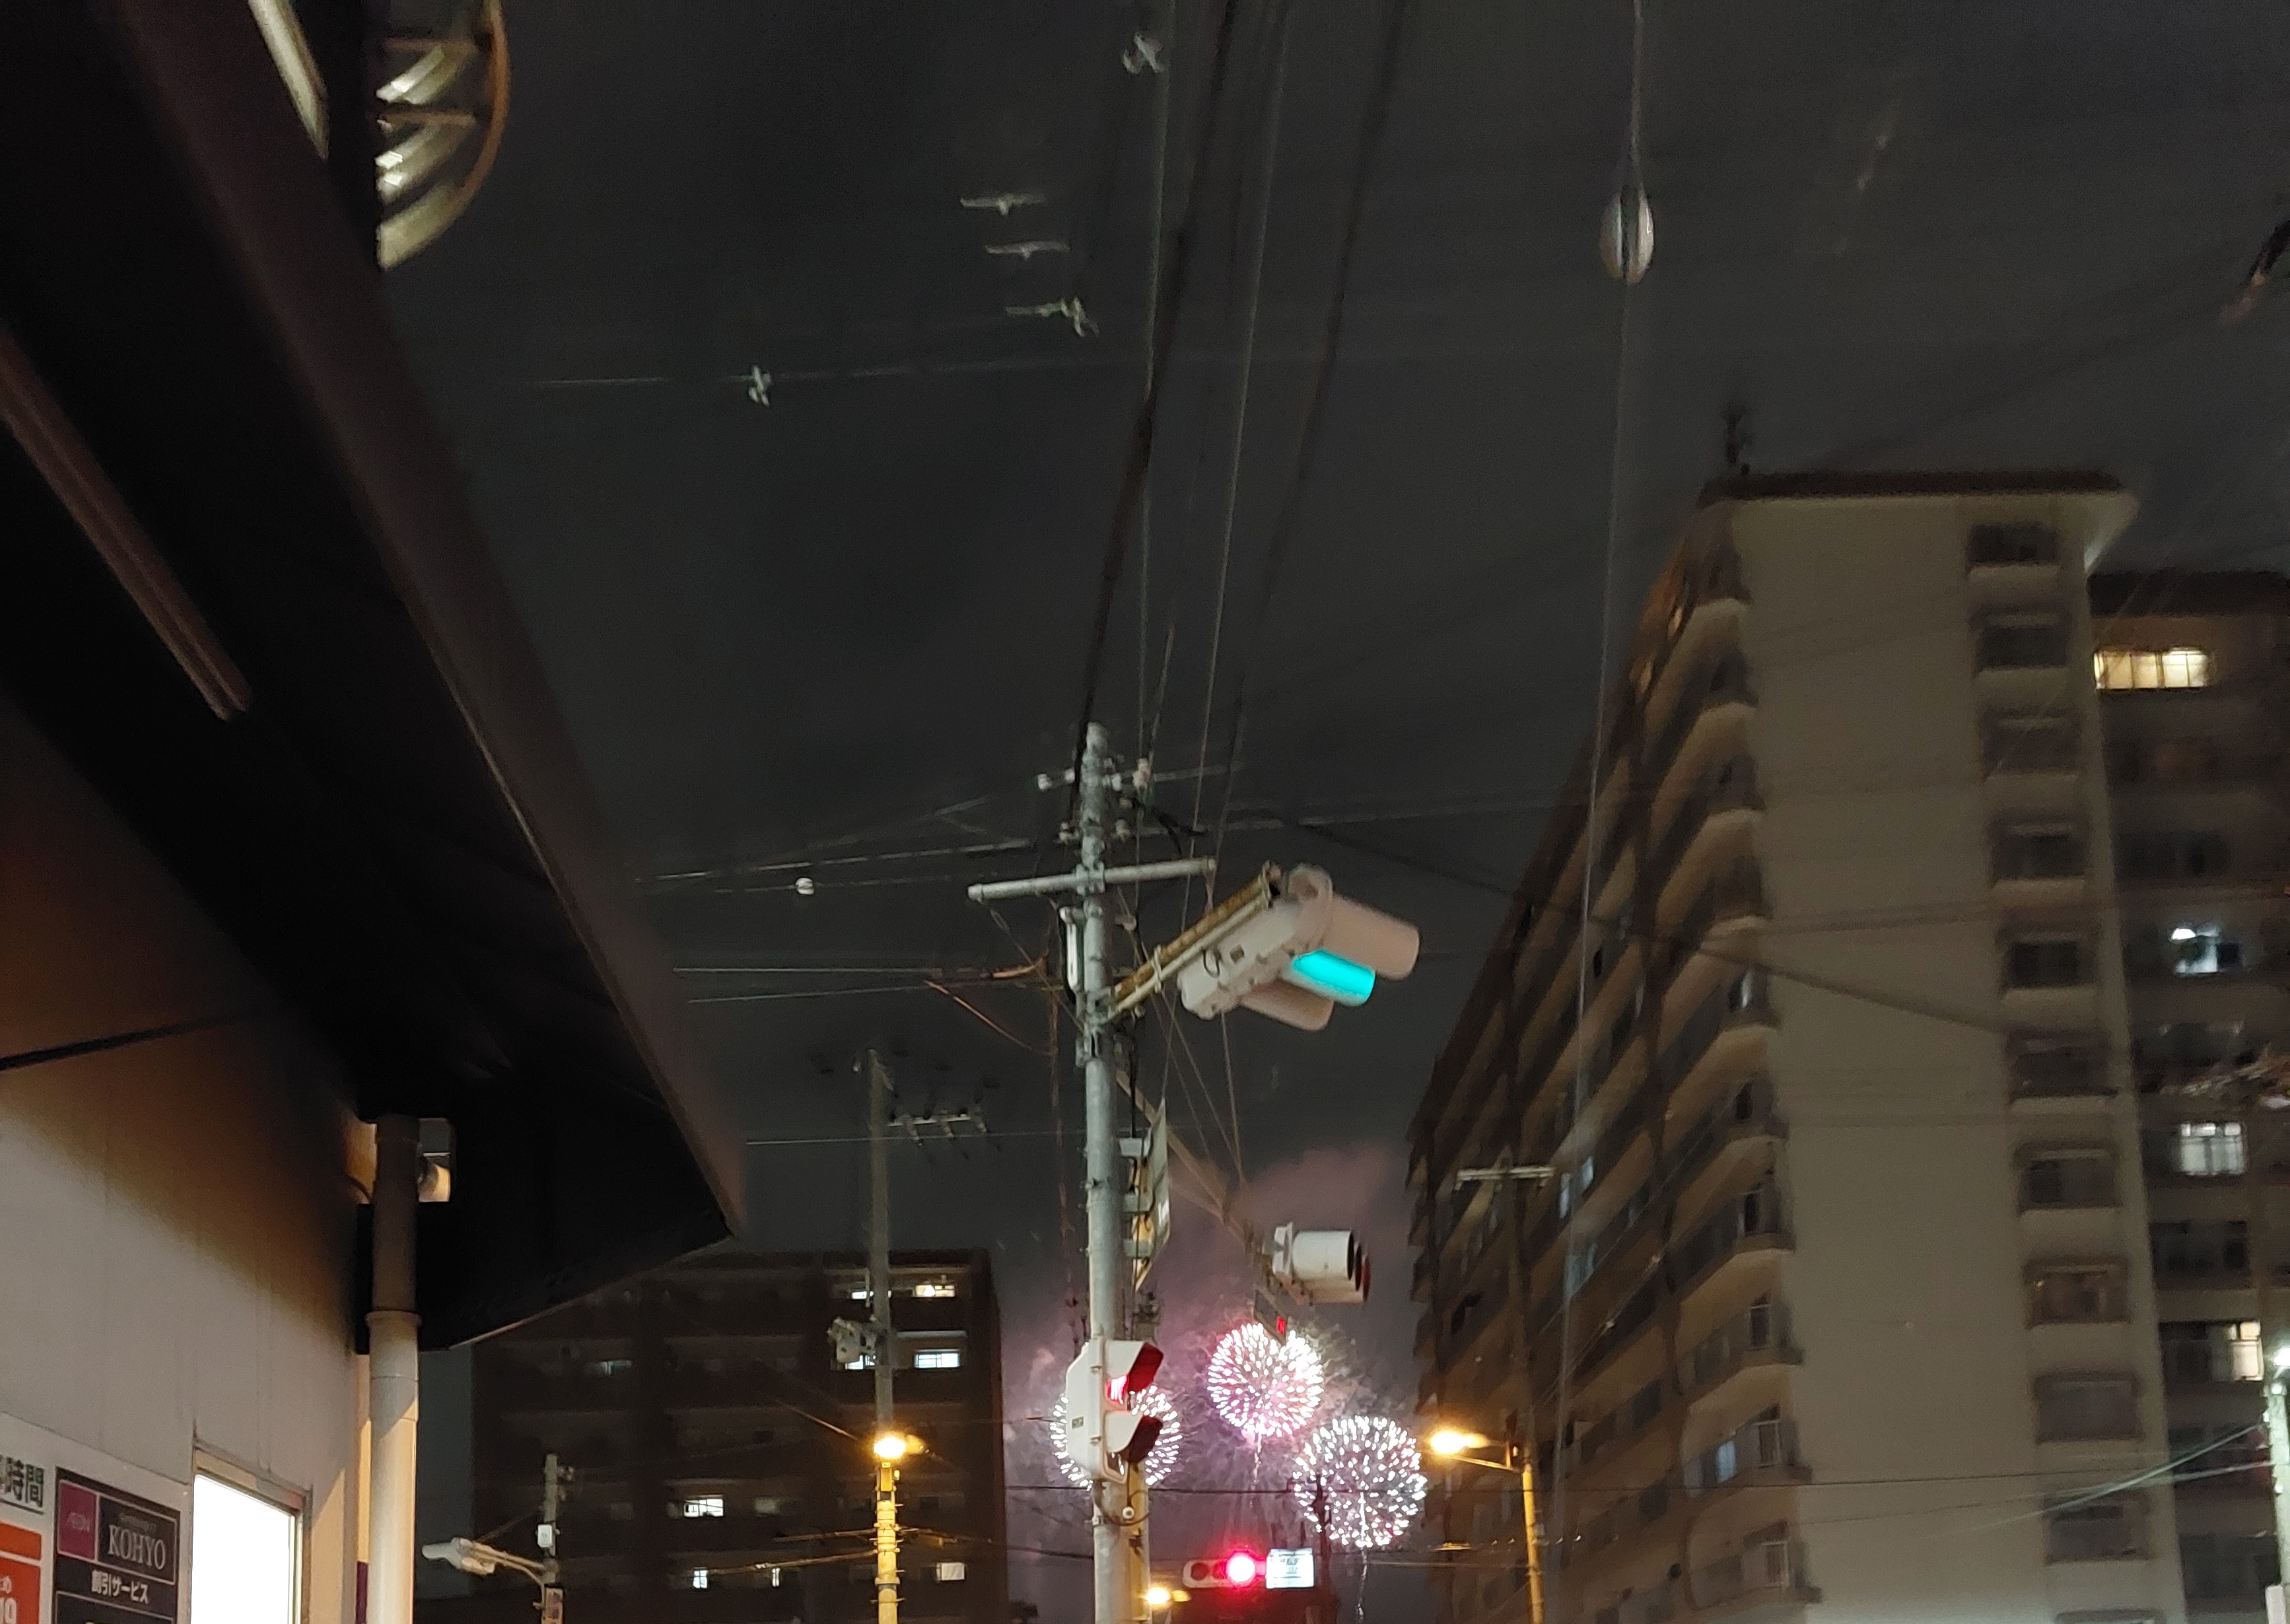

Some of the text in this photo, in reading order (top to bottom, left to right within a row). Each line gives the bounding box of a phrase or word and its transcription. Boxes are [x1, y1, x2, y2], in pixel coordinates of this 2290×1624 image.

[108, 1524, 165, 1571] KOHYO
[91, 1569, 149, 1604] 割引サービス
